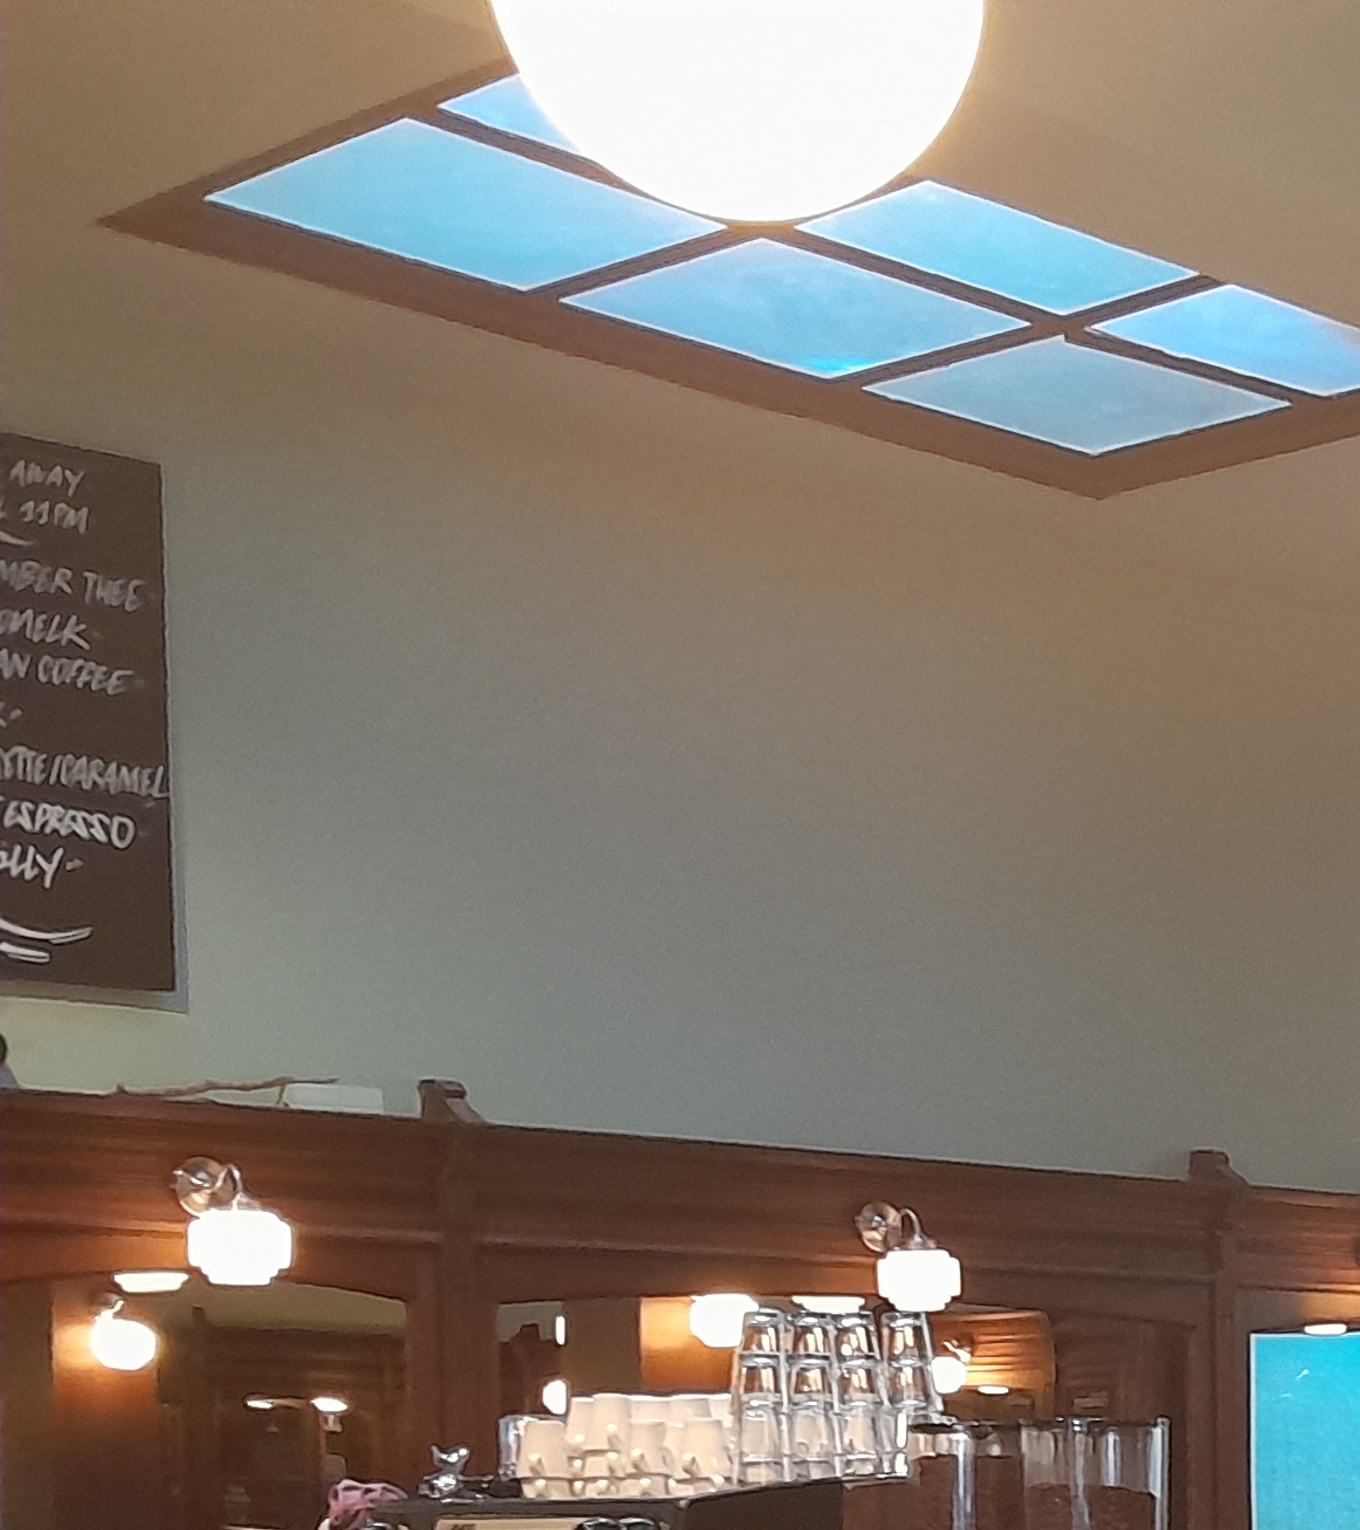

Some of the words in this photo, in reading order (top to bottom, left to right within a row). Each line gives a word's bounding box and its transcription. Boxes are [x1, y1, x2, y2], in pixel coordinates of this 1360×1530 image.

[9, 459, 86, 497] AWAY
[37, 654, 135, 696] COFFEE
[3, 800, 136, 849] ESPRESSO
